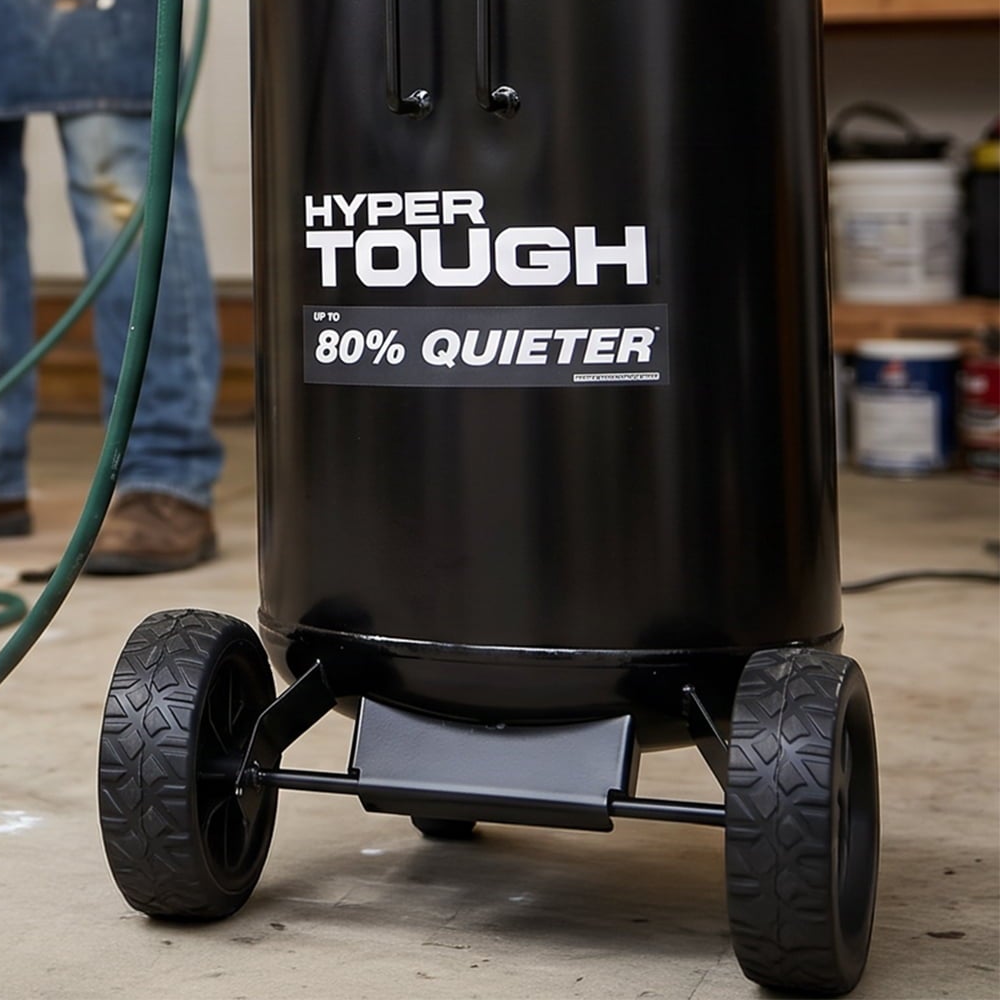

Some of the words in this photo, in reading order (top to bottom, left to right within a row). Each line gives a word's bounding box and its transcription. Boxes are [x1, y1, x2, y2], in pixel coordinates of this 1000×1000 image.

[305, 190, 485, 227] HYPER
[306, 226, 648, 287] TOUGH
[313, 312, 326, 321] UP
[327, 312, 340, 321] TO
[315, 329, 405, 365] 80%
[422, 328, 655, 368] QUIETER
